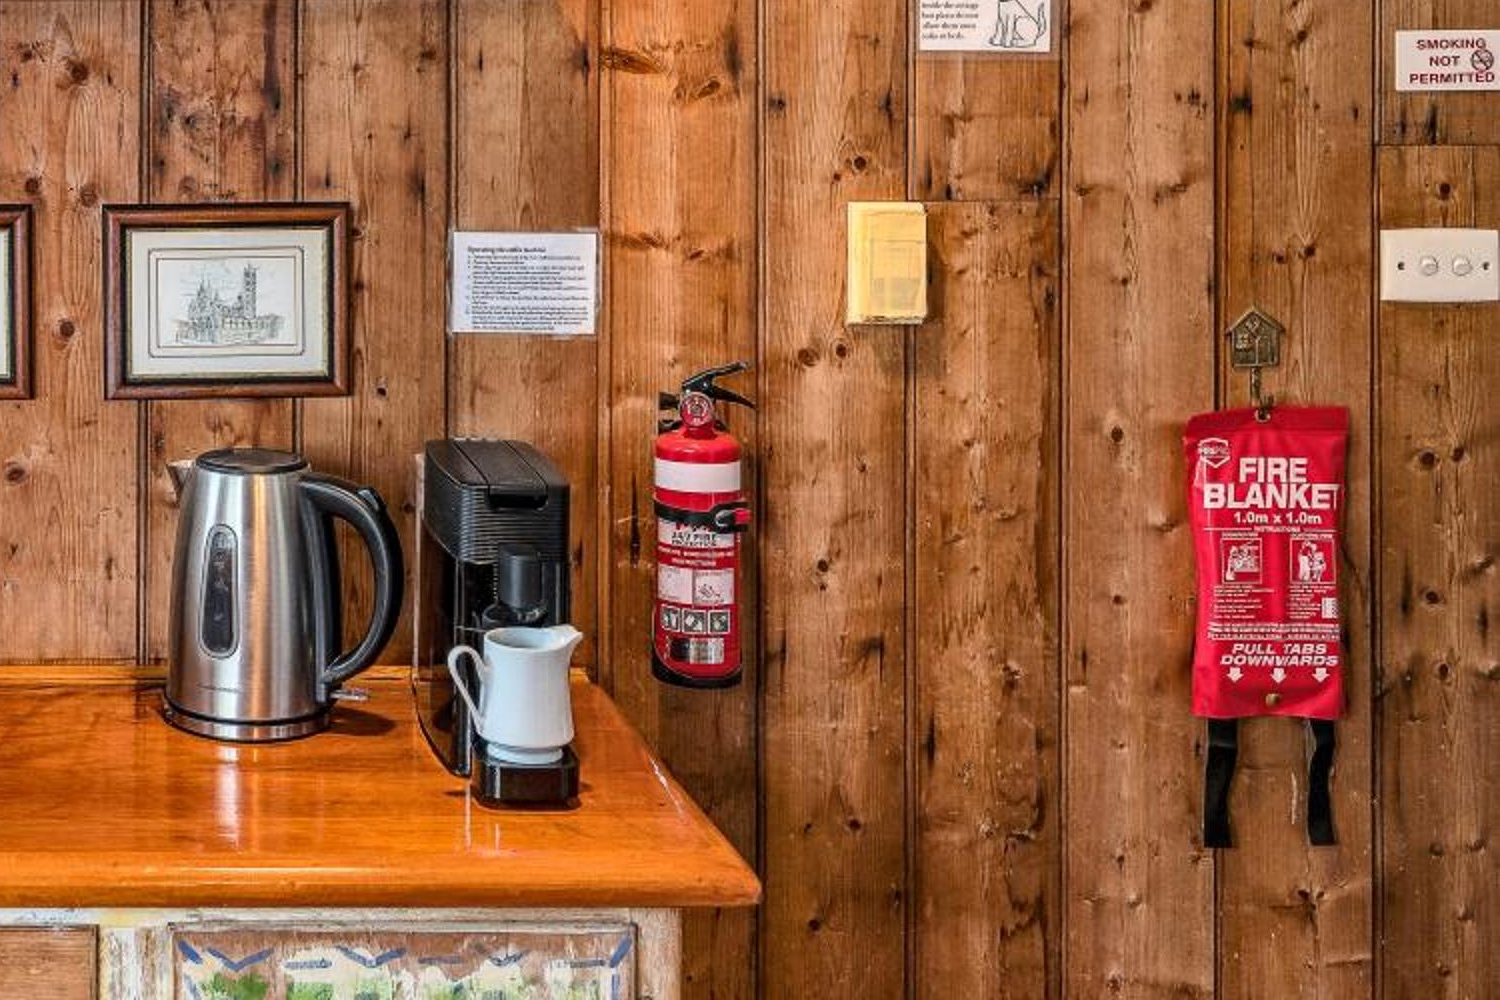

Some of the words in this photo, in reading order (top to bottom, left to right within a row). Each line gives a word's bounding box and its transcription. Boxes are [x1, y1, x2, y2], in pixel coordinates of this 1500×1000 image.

[1416, 38, 1487, 50] SMOKING
[1429, 55, 1460, 67] NOT
[1409, 72, 1495, 84] PERMITTED
[1239, 457, 1308, 483] FIRE
[1203, 483, 1340, 511] BLANKET
[1233, 511, 1269, 524] 1.0m
[1273, 514, 1282, 524] x
[1286, 511, 1322, 525] 1.0m
[1231, 643, 1277, 655] PULL
[1283, 643, 1327, 655] TABS
[1220, 654, 1339, 667] DOWNWARDS
